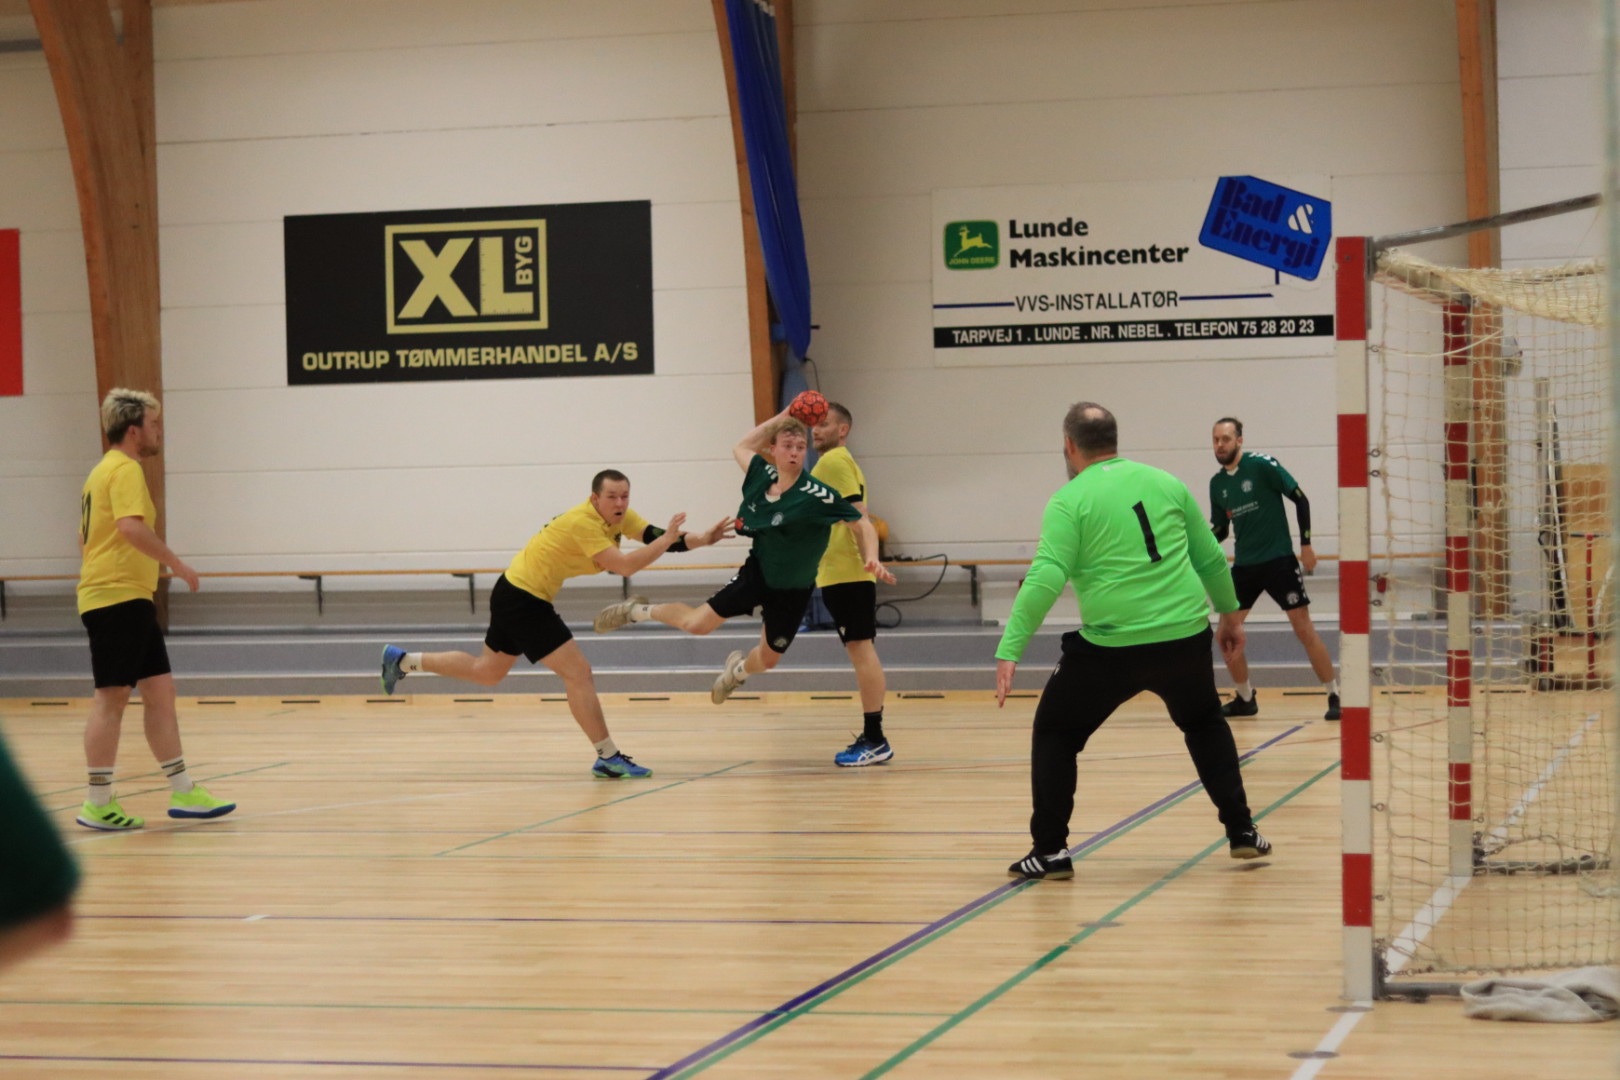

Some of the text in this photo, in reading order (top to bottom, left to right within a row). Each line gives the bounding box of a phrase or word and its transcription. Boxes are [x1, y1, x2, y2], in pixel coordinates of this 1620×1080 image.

[1219, 177, 1287, 224] Bad
[1008, 217, 1089, 239] Lunde
[1209, 206, 1320, 268] Energi
[515, 235, 534, 286] BYG
[948, 256, 995, 266] JOHN DEERE
[1009, 243, 1190, 268] Maskincenter
[397, 237, 534, 319] XL
[1015, 290, 1179, 313] VVS-INSTALLATØR
[952, 318, 1315, 344] TARPVEJ 1 LUNDE NR. NEBEL TELEFON 75 28 20 23
[302, 341, 639, 371] OUTRUP TØMMERHANDEL A/S
[1131, 500, 1162, 563] 1
